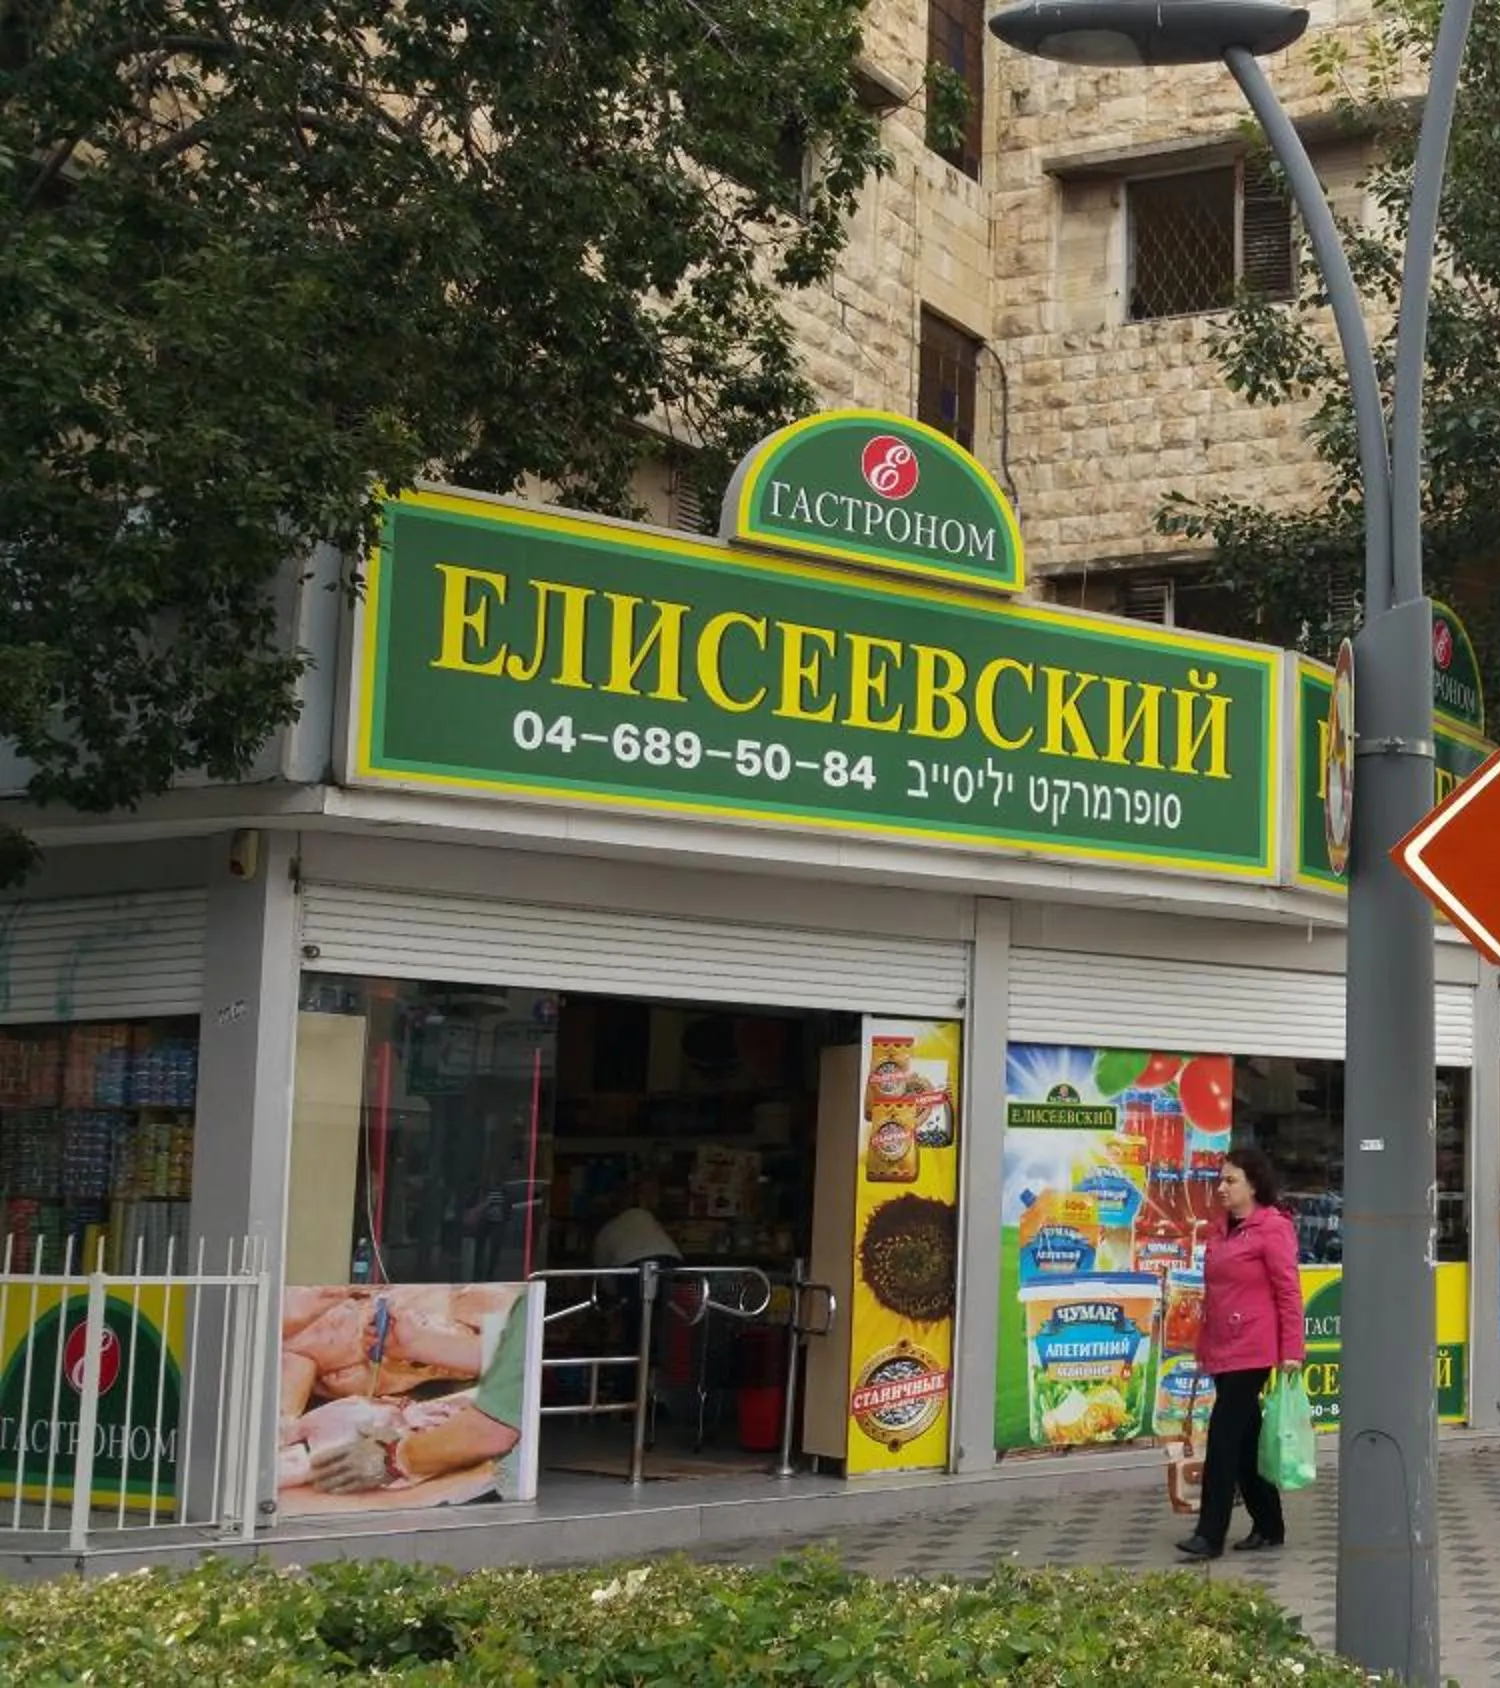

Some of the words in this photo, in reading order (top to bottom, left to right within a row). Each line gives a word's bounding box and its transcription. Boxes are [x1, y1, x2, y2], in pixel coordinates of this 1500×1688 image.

[770, 480, 997, 561] ГАСТРОНОМ
[430, 563, 1232, 779] ЕЛИСЕЕВСКИЙ
[513, 710, 876, 790] 04-689-50-84
[907, 757, 1014, 807] יליסייב
[1029, 774, 1182, 829] סופרמרקט
[1056, 1304, 1120, 1323] ЧУМАК
[853, 1373, 945, 1409] СТАНИЧНЫЕ
